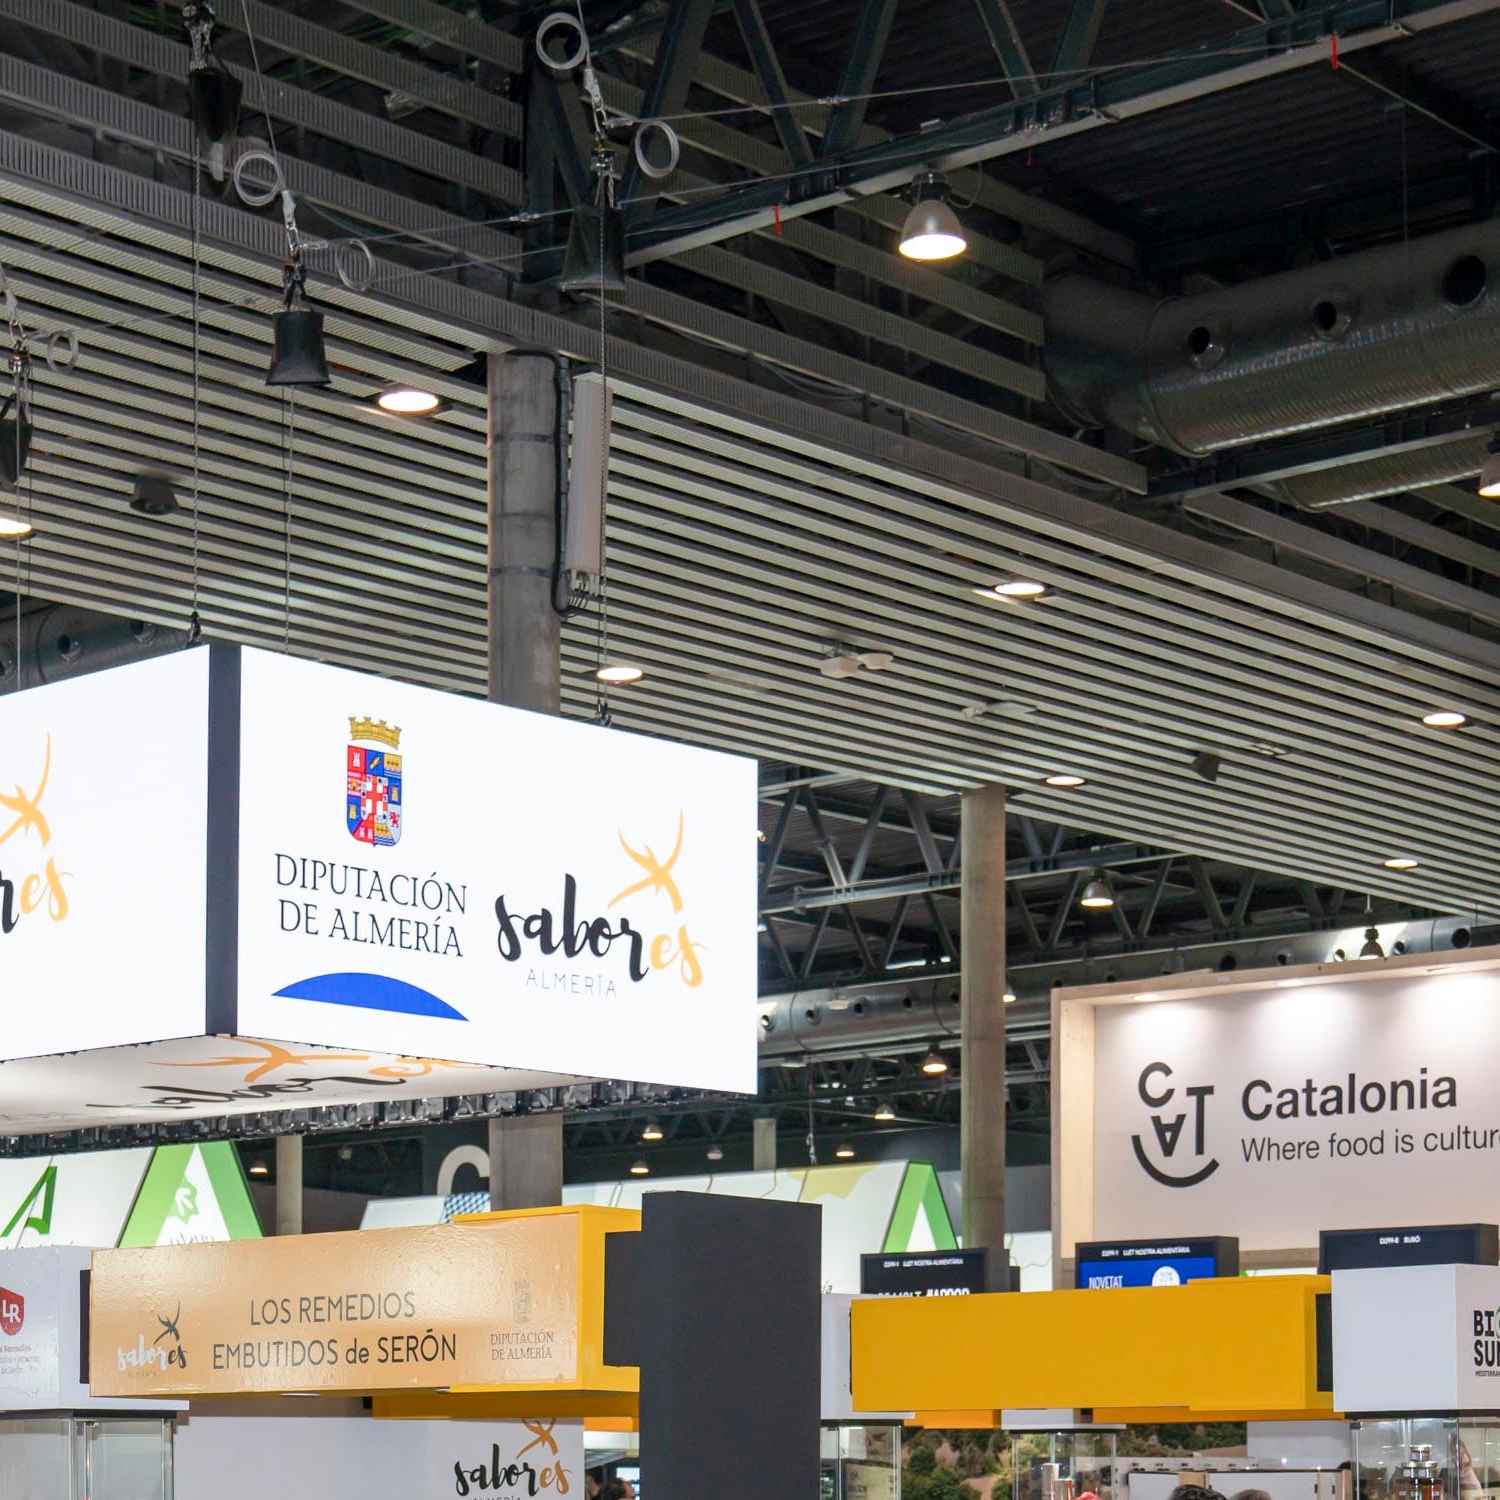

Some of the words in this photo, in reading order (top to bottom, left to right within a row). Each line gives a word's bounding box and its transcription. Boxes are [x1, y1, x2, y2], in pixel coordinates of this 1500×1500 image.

[275, 853, 467, 914] DIPUTACIÓN
[279, 900, 319, 935] DE
[328, 908, 464, 957] ALMERÍA
[495, 873, 708, 988] sabores
[526, 968, 618, 999] ALMERÍA
[1241, 1067, 1457, 1121] Catalonia
[1241, 1137, 1320, 1163] Where
[1328, 1131, 1384, 1158] food
[1394, 1128, 1414, 1153] is
[1088, 1276, 1123, 1290] NOVETAT
[250, 1298, 291, 1326] LOS
[299, 1291, 416, 1323] REMEDIOS
[117, 1333, 189, 1372] sabores
[213, 1337, 338, 1370] EMBUTIDOS
[345, 1342, 370, 1364] de
[377, 1329, 457, 1363] SERÓN
[491, 1329, 554, 1346] DIPUTACIÓN
[491, 1349, 505, 1361] DE
[508, 1345, 553, 1360] ALMERÍA
[454, 1443, 573, 1497] sabores
